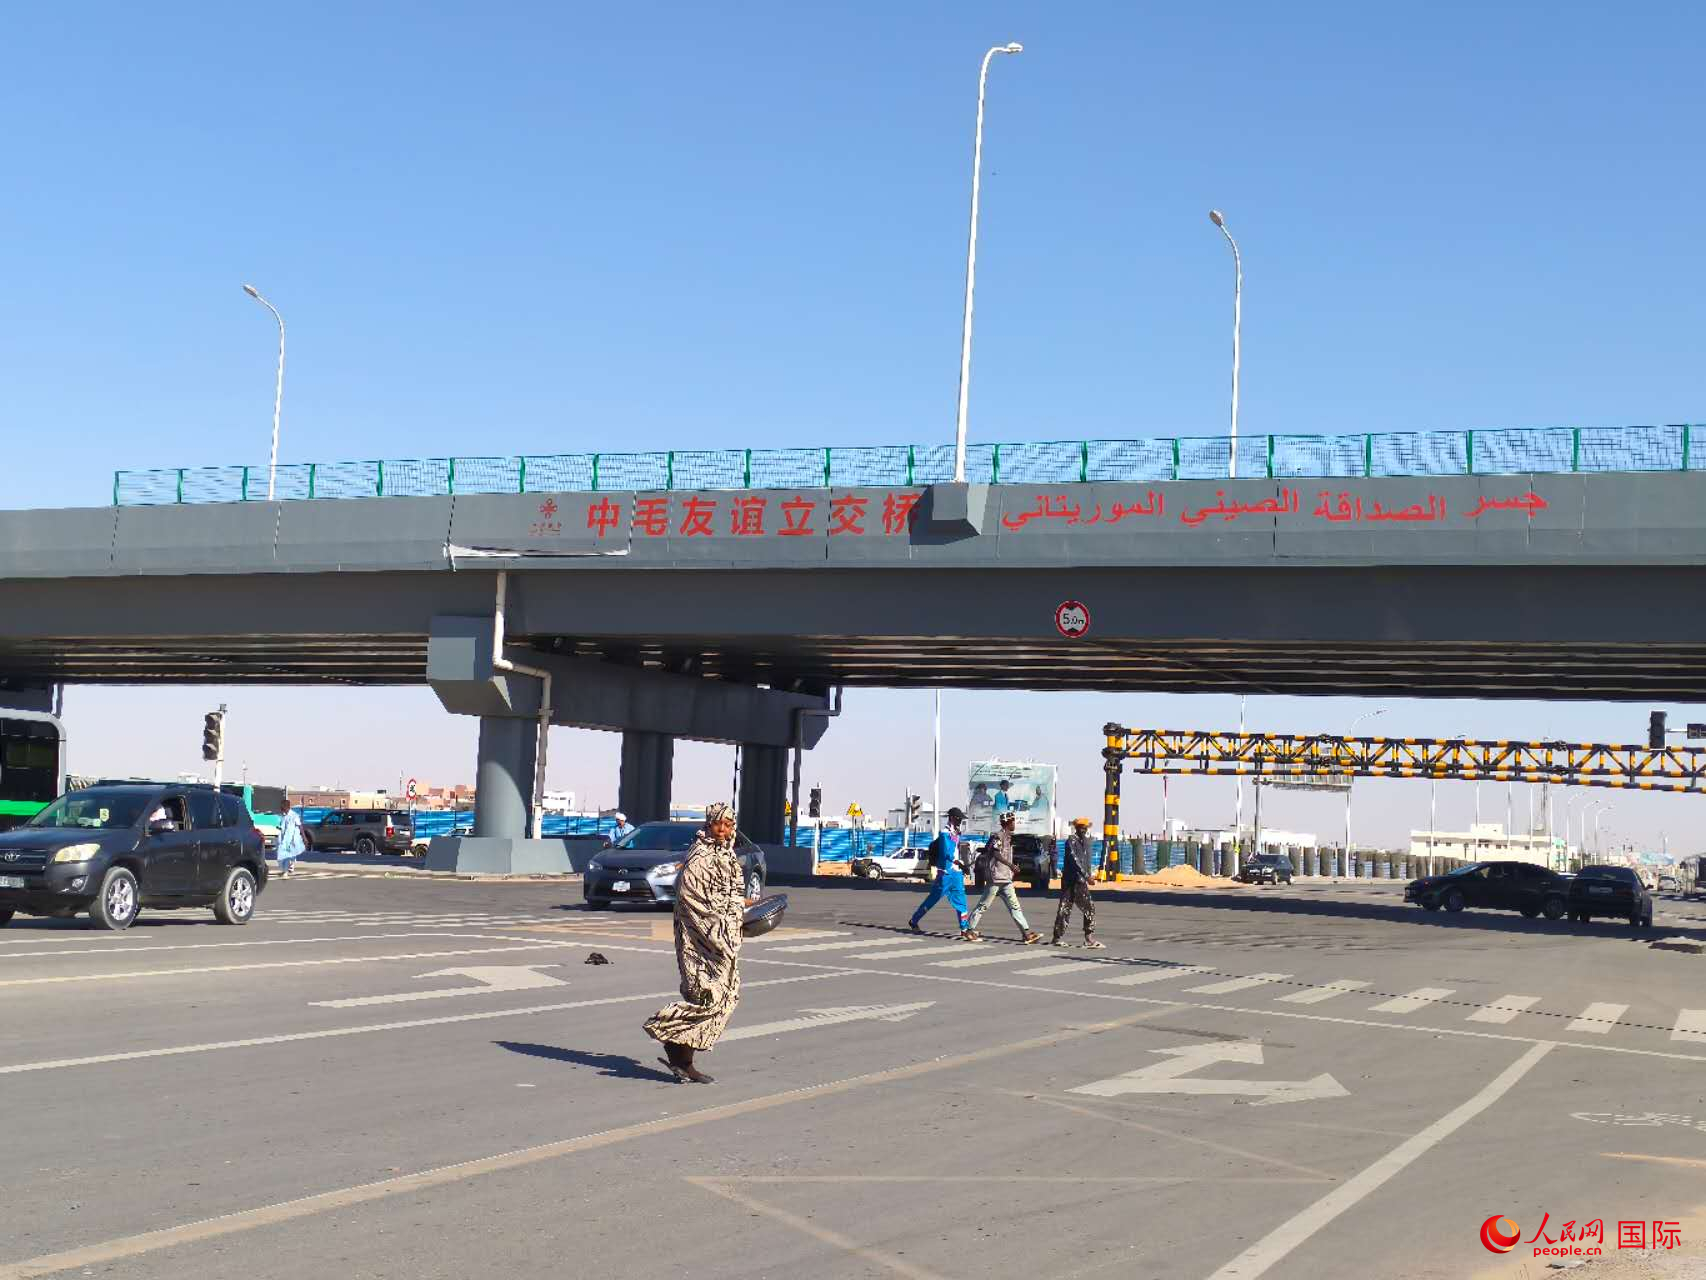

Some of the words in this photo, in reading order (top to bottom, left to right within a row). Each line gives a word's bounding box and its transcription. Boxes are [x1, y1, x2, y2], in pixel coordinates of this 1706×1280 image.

[588, 493, 922, 539] 中毛友谊立交桥
[1180, 488, 1300, 528] الصيني
[1313, 490, 1447, 522] الصداقة
[1464, 491, 1549, 519] جسر
